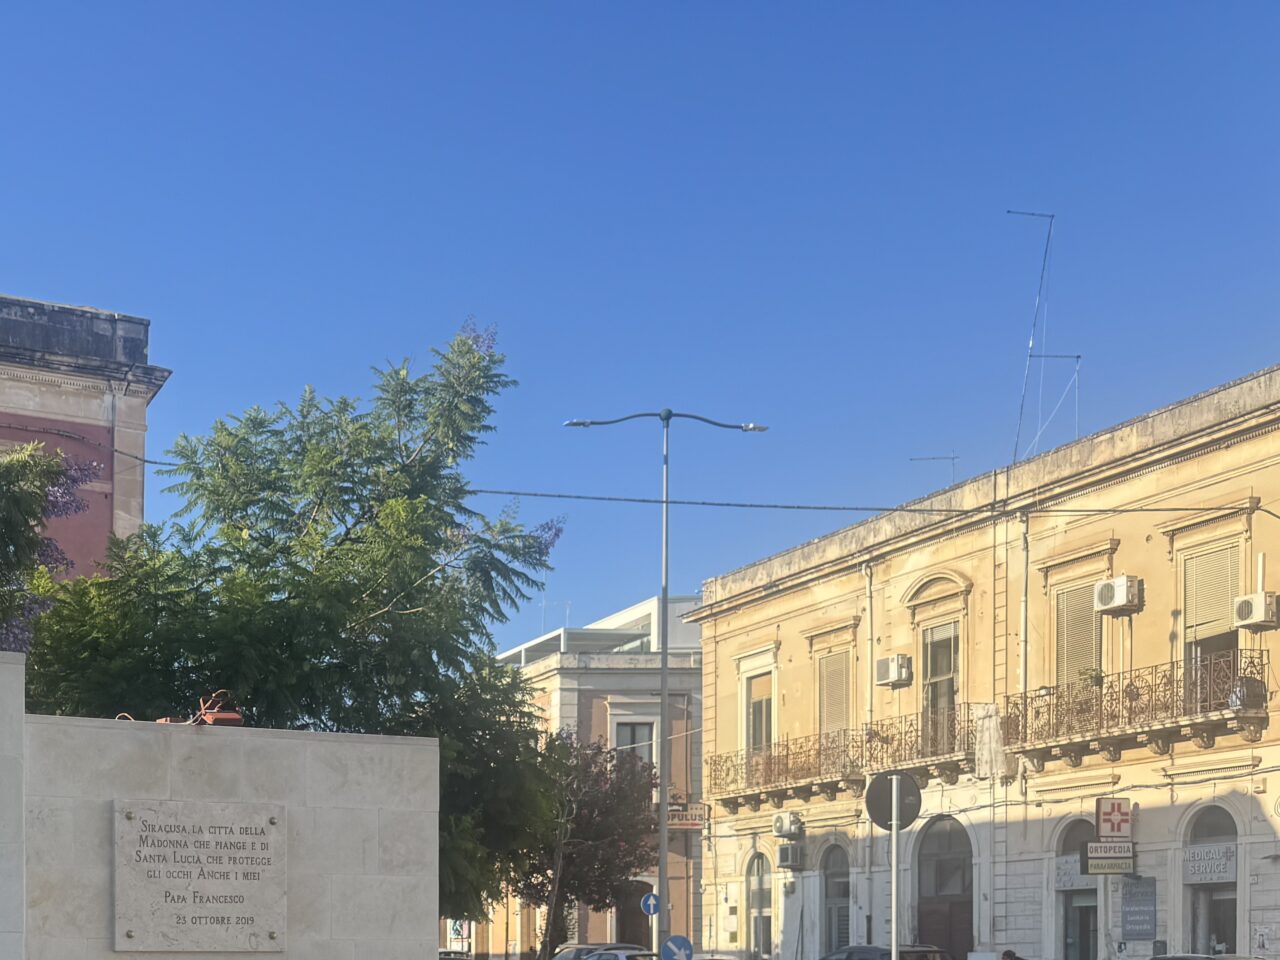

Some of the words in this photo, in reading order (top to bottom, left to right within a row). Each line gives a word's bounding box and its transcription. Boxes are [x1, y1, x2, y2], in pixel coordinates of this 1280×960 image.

[192, 825, 203, 834] LA
[239, 826, 266, 836] DELLA
[138, 834, 189, 849] MADONNA
[193, 840, 211, 849] CHE
[215, 841, 247, 851] PIANGE
[251, 842, 257, 851] E
[260, 842, 269, 851] DI
[1088, 845, 1131, 854] ORTOPEDIA
[135, 849, 168, 863] SANTA
[173, 850, 202, 864] LUCIA
[206, 855, 224, 865] CHE
[227, 856, 272, 866] PROTEGGE
[1184, 847, 1222, 861] MEDICAL
[146, 870, 161, 879] GLI
[166, 870, 193, 880] OCCHI
[197, 866, 231, 880] ANCHE
[1189, 861, 1227, 874] SERVICE
[164, 890, 186, 904] PAPA
[192, 890, 245, 904] FRANCESCO
[176, 915, 187, 925] 23
[190, 916, 231, 925] OTTOBRE
[235, 916, 255, 925] 2019
